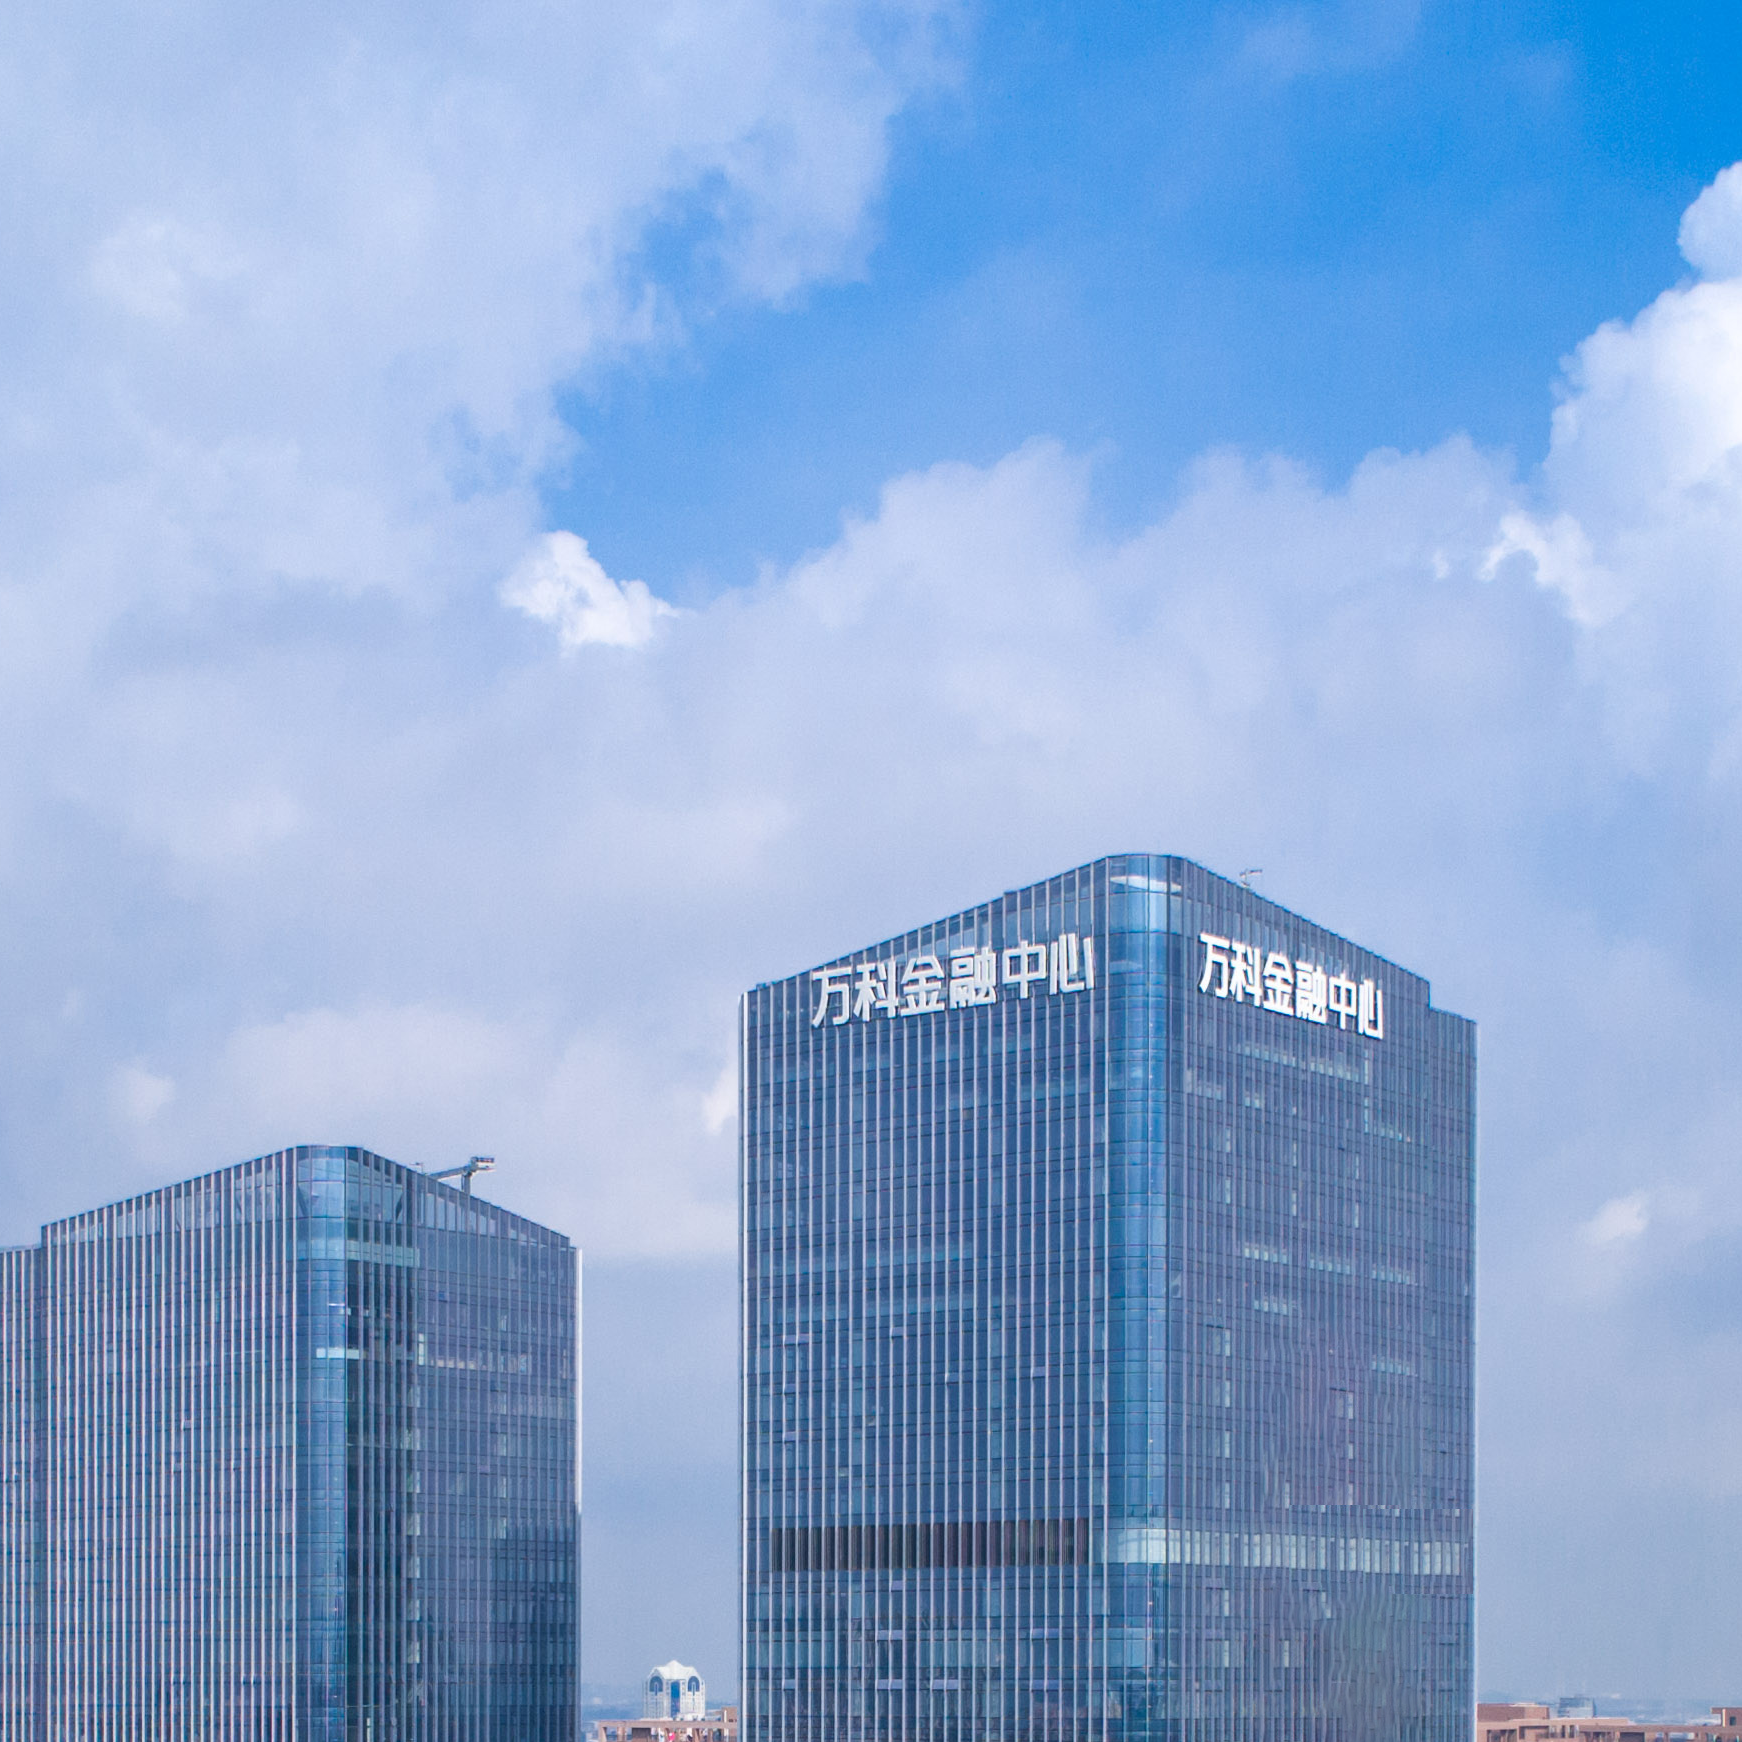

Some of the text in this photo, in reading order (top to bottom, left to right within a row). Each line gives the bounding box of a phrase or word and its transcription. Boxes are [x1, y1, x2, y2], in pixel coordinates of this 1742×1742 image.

[811, 932, 1095, 1029] 万科金融中心
[1197, 932, 1385, 1041] 万科金融中心
